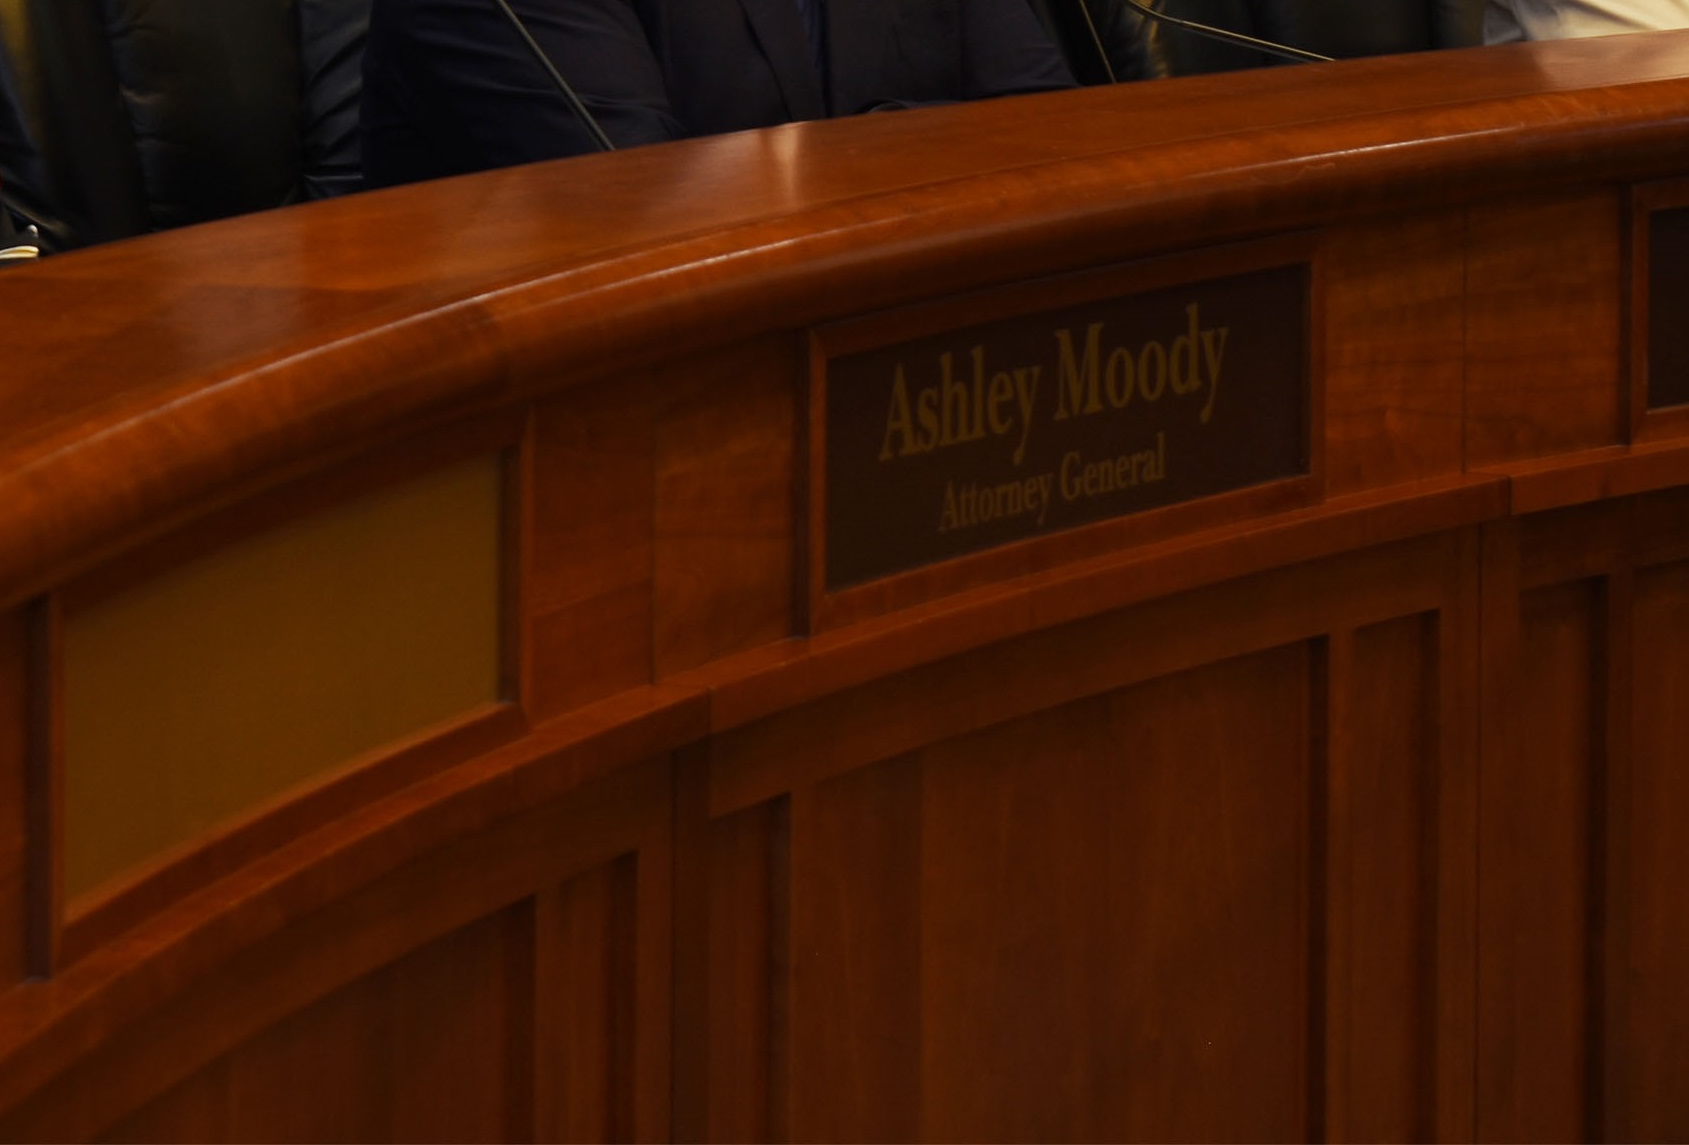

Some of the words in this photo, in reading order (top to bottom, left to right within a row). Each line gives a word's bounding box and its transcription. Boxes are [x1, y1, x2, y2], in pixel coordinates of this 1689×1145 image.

[878, 346, 1042, 465] Ashley
[1054, 302, 1229, 423] Moody
[938, 477, 1052, 534] Attorney
[1061, 433, 1167, 502] General
